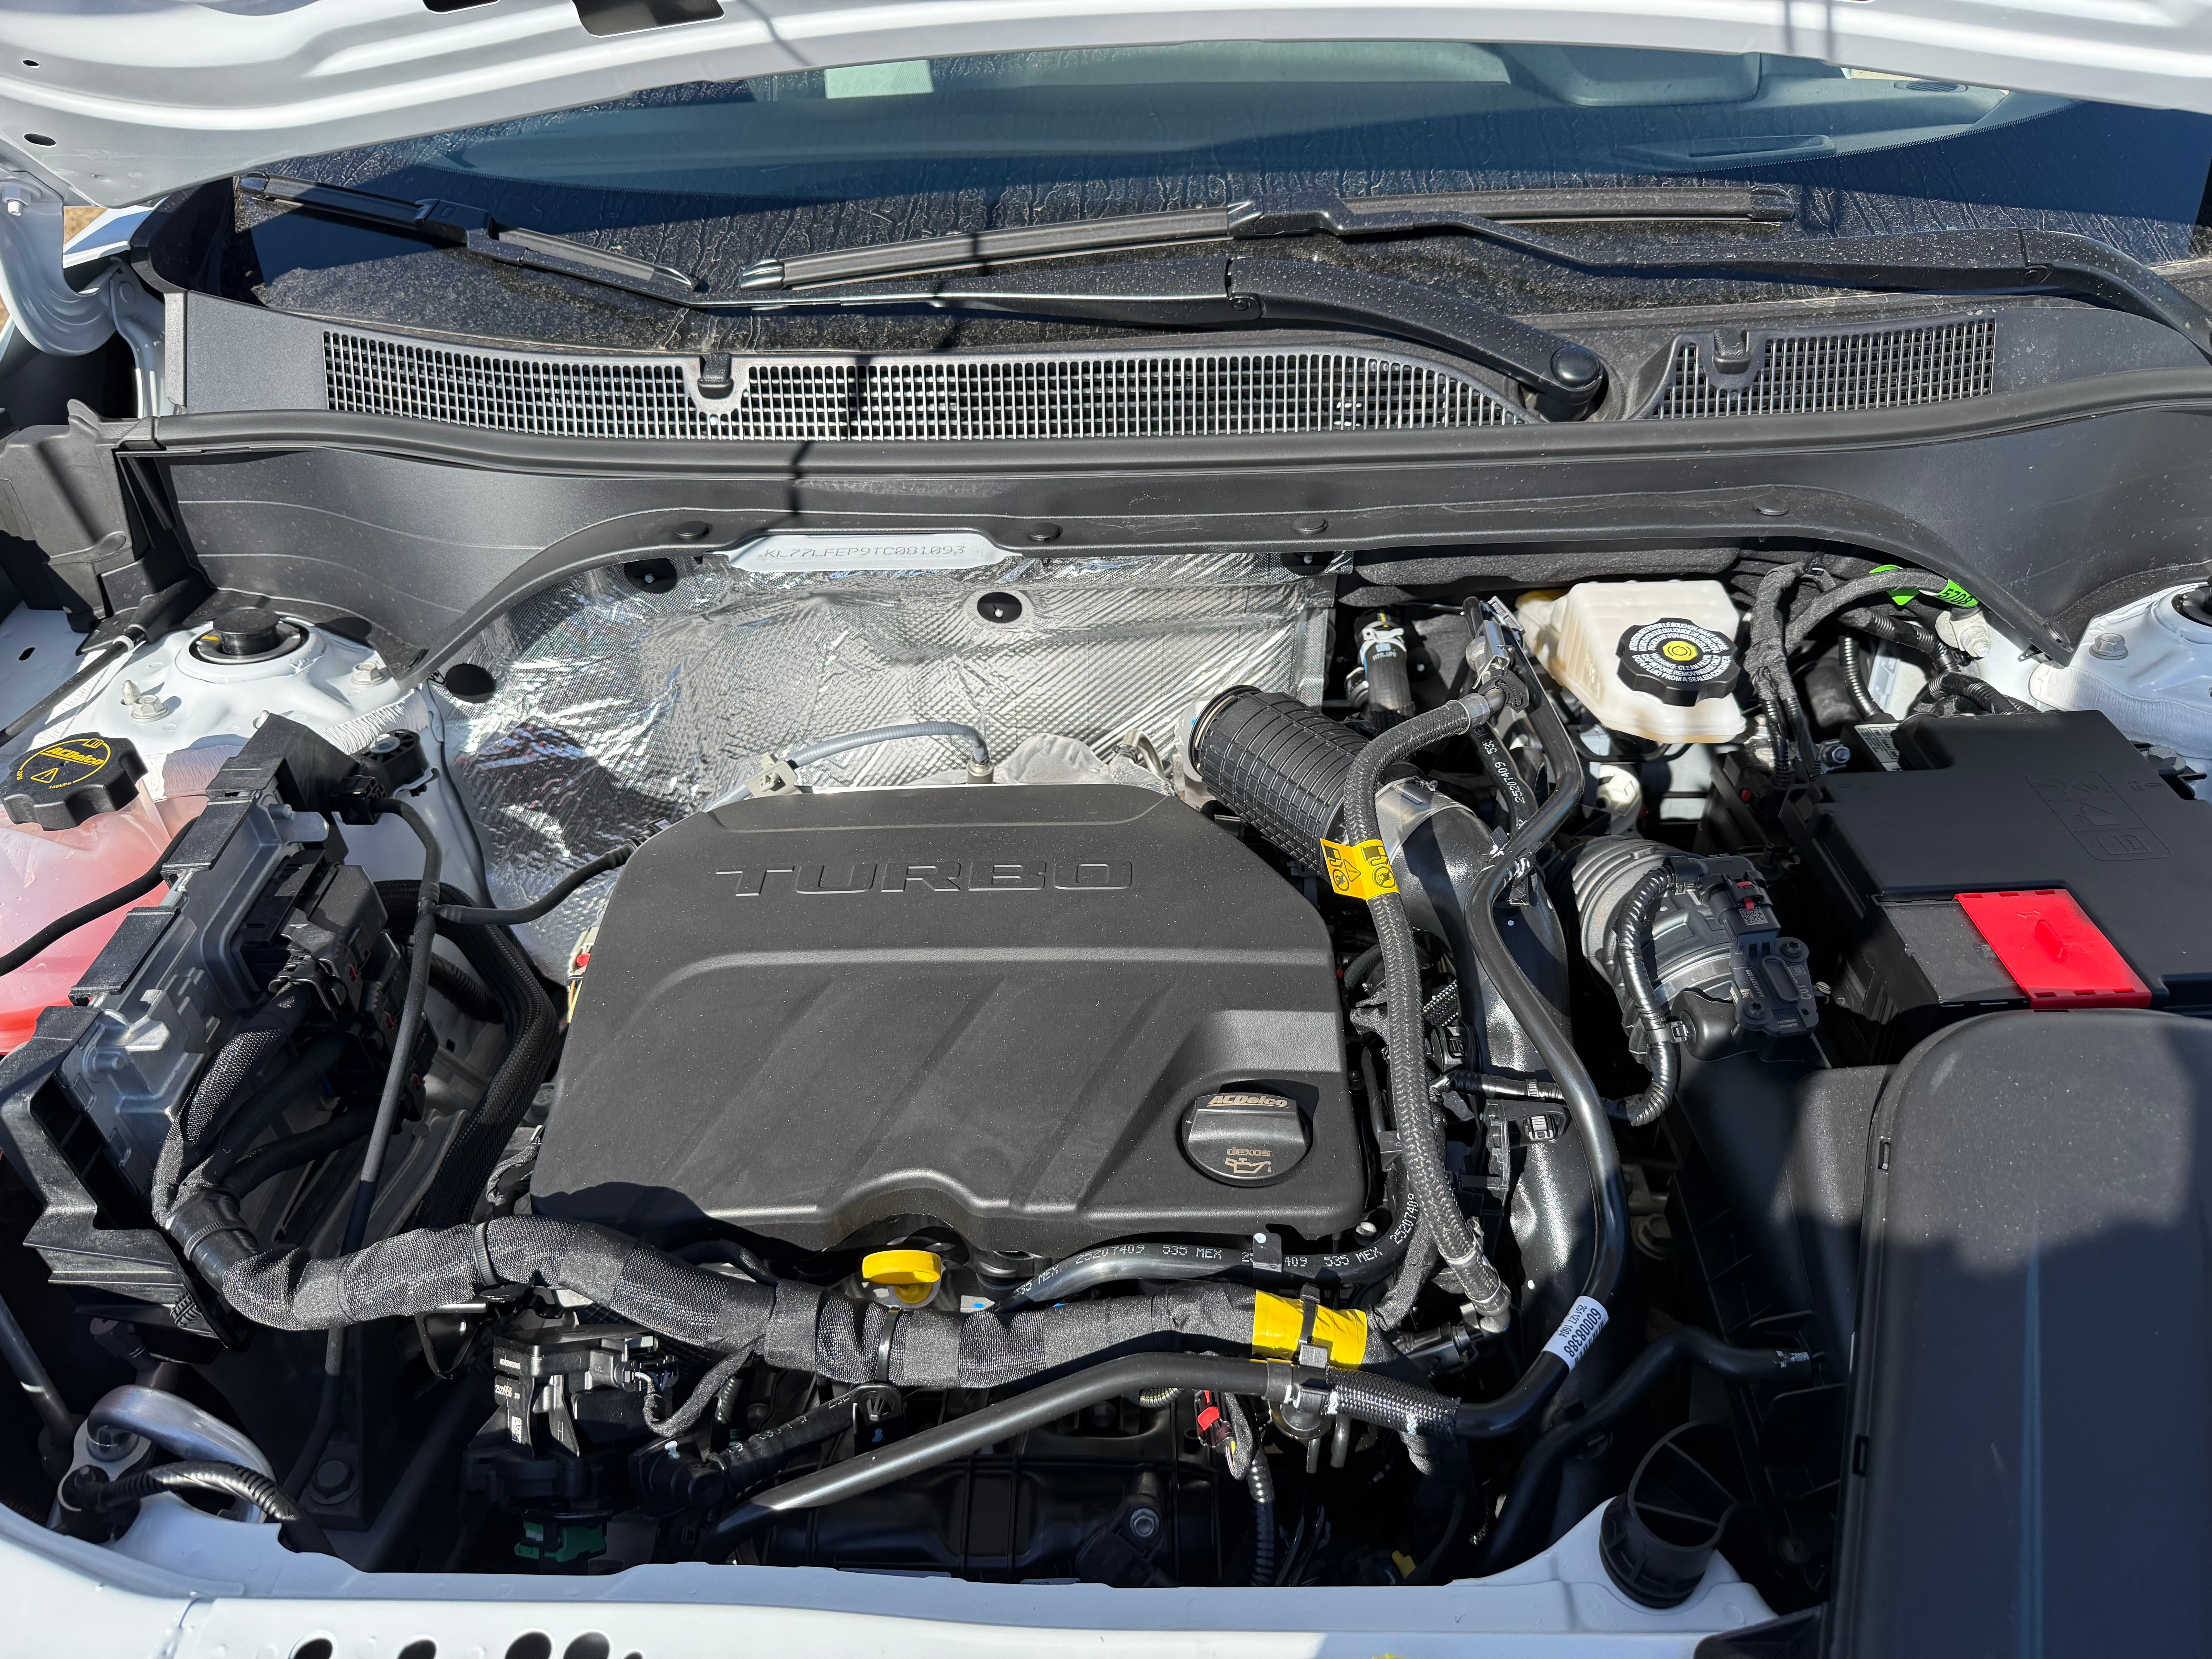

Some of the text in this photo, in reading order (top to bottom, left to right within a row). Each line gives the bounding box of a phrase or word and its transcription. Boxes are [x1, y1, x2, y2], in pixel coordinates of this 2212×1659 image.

[1937, 588, 1973, 605] 5708
[1671, 622, 1698, 631] BOUCHON
[1696, 628, 1717, 639] AVANT
[1641, 653, 1654, 662] CAP
[1649, 661, 1674, 674] BEFORE
[1710, 655, 1722, 666] ONLY
[1697, 654, 1713, 667] FILLER
[1643, 665, 1663, 676] FLUID
[1661, 673, 1682, 682] FROM
[1688, 673, 1714, 682] SEALED
[1482, 739, 1498, 755] 535
[46, 747, 105, 766] ACDelco
[49, 781, 72, 790] 140kPa
[1494, 761, 1525, 804] 25207409
[715, 860, 1132, 896] TURBO
[1208, 1094, 1288, 1107] ACDelco
[1226, 1146, 1271, 1157] dexos
[1038, 1264, 1059, 1285] MEX
[1075, 1244, 1145, 1264] 25207409
[1163, 1245, 1188, 1255] 535
[1196, 1247, 1222, 1259] MEX
[1323, 1255, 1350, 1267] 535
[1355, 1247, 1383, 1263] MEX
[1558, 1324, 1573, 1338] 1604
[1563, 1307, 1602, 1357] 60008388
